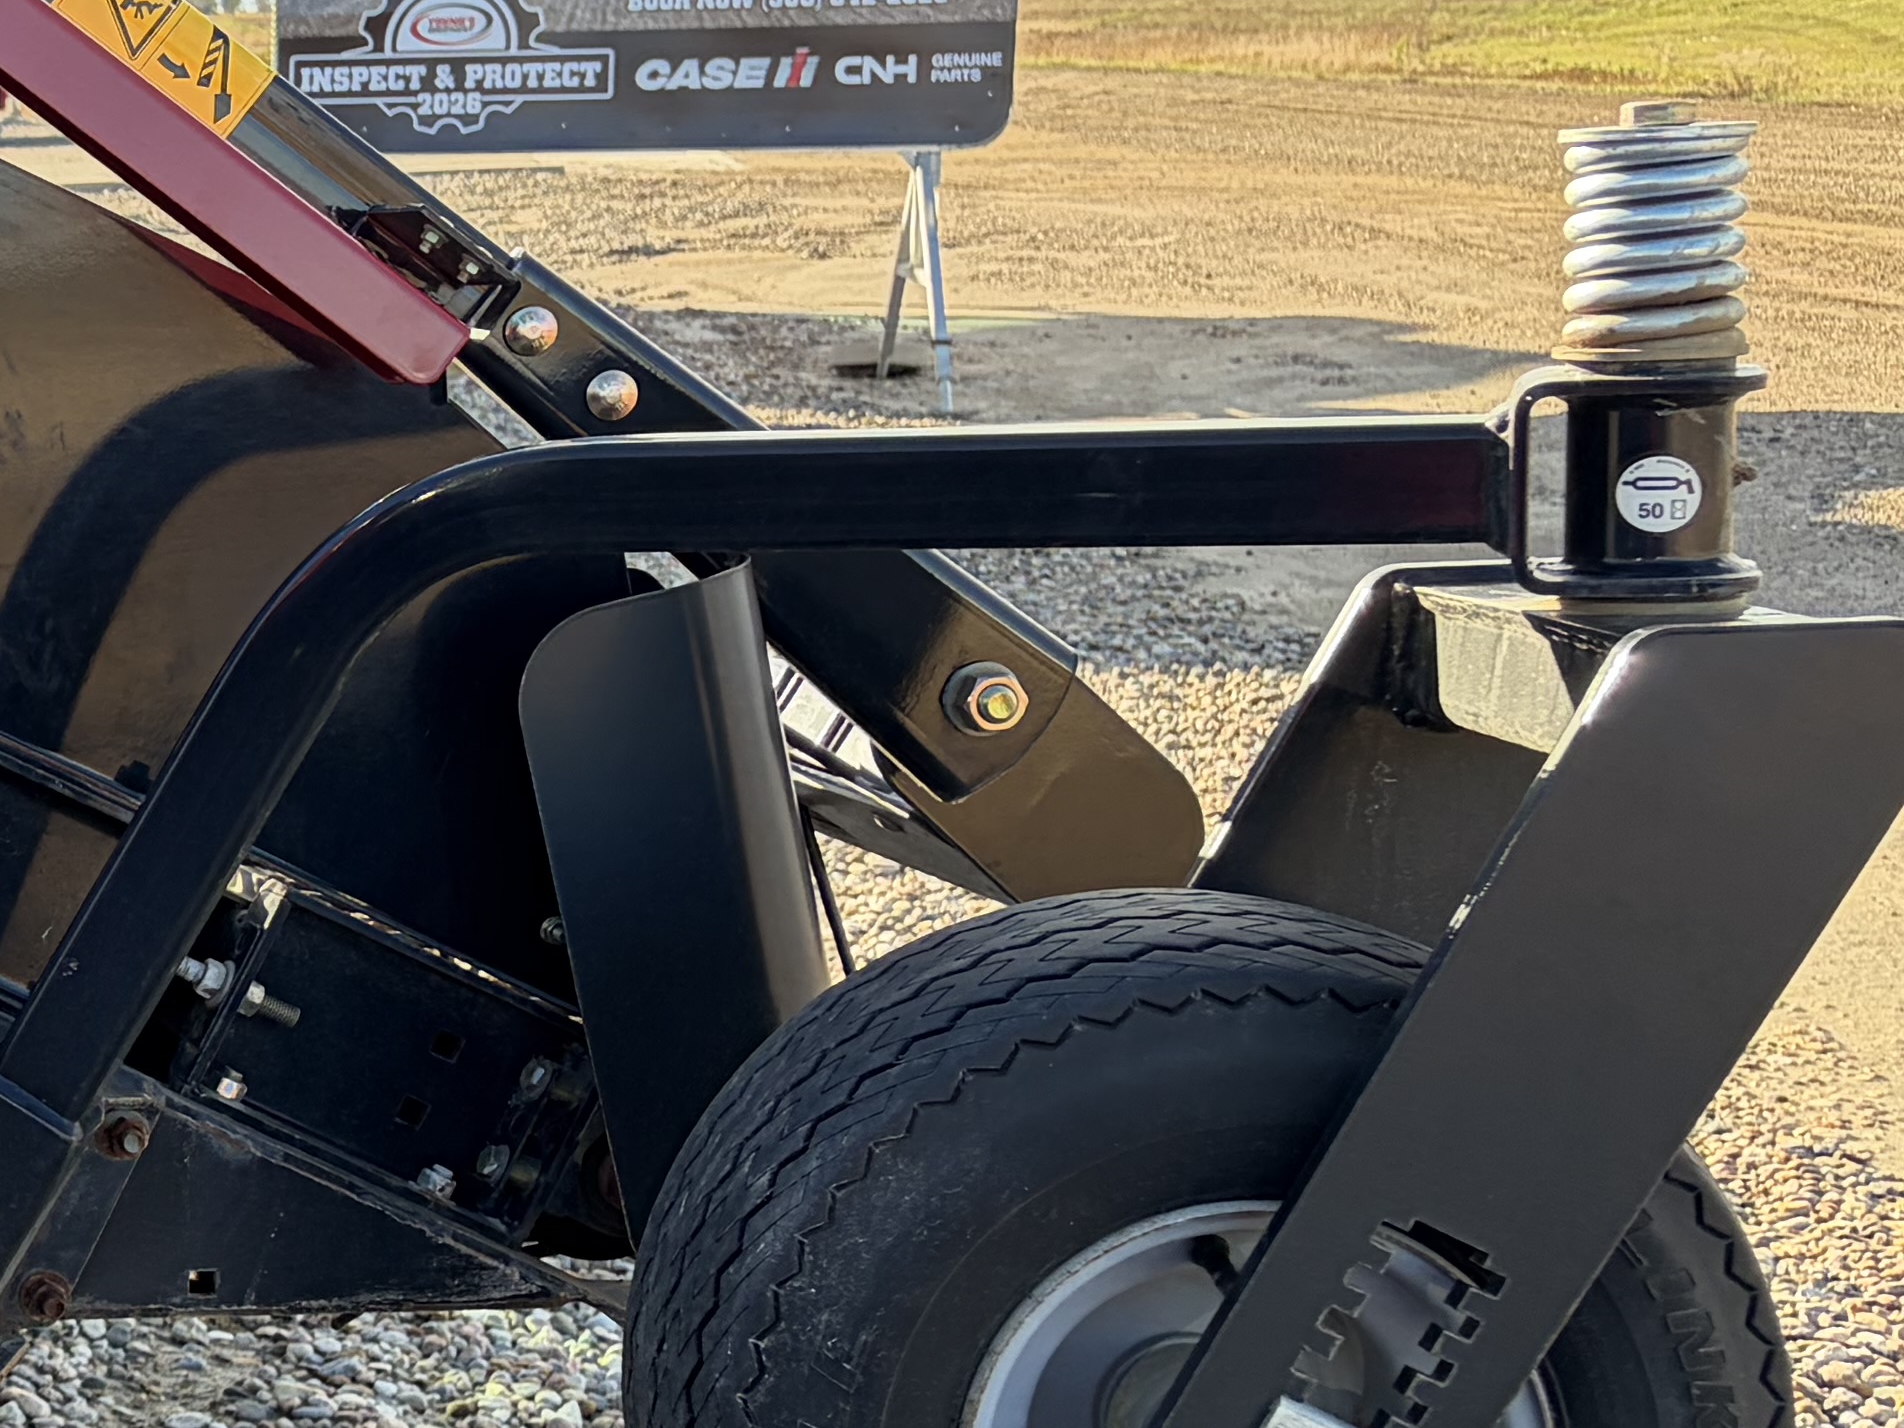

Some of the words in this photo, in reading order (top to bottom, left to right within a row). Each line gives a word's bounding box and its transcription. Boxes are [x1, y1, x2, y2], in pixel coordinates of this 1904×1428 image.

[932, 52, 1003, 68] GENUINE
[300, 65, 426, 92] INSPECT
[434, 63, 455, 90] &
[464, 61, 601, 89] PROTECT
[635, 57, 771, 91] CASE
[834, 54, 916, 85] CNH
[417, 91, 482, 115] 2026
[1638, 502, 1664, 519] 50
